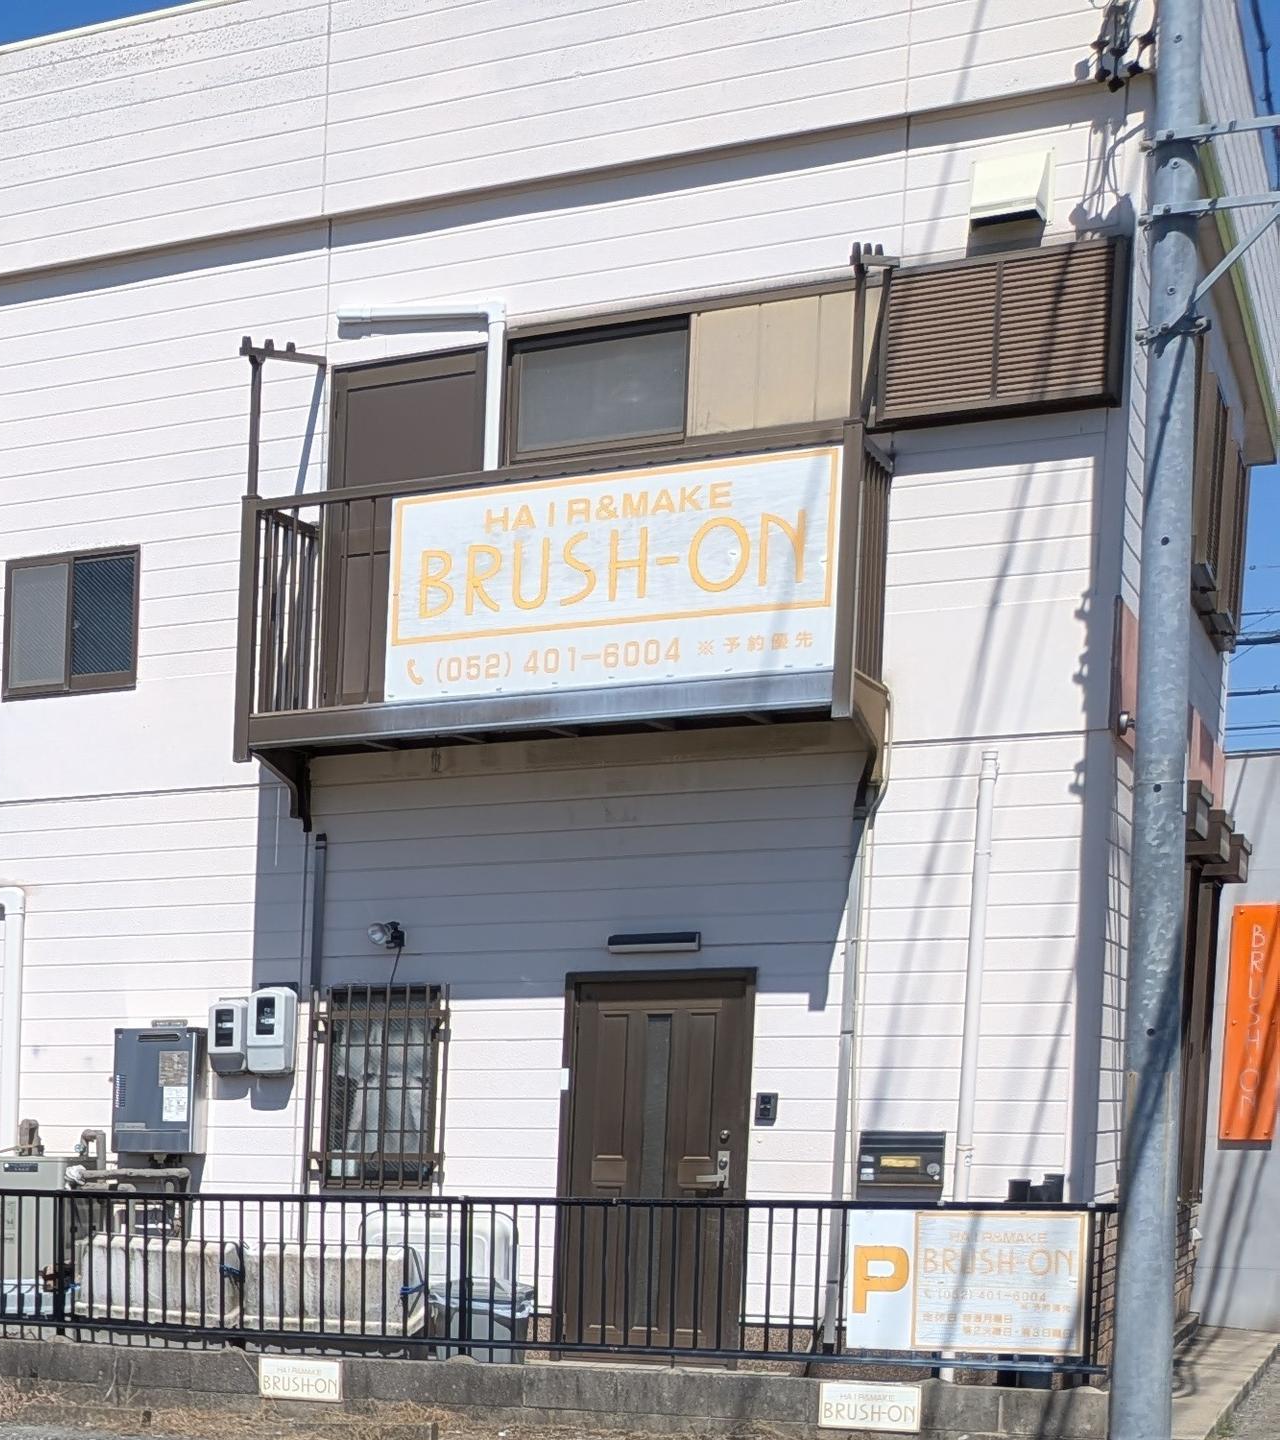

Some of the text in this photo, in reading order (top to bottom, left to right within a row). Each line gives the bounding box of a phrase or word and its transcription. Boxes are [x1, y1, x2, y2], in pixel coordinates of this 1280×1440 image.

[485, 481, 734, 534] HAIR&MAKE
[419, 509, 807, 619] BRUSH-ON
[436, 652, 512, 683] (052)
[523, 637, 681, 674] 401-6004
[852, 1244, 910, 1314] P
[924, 1248, 1073, 1275] BRUSH-ON
[263, 1375, 338, 1394] BRUSH-ON
[824, 1402, 915, 1423] BRUSH-ON
